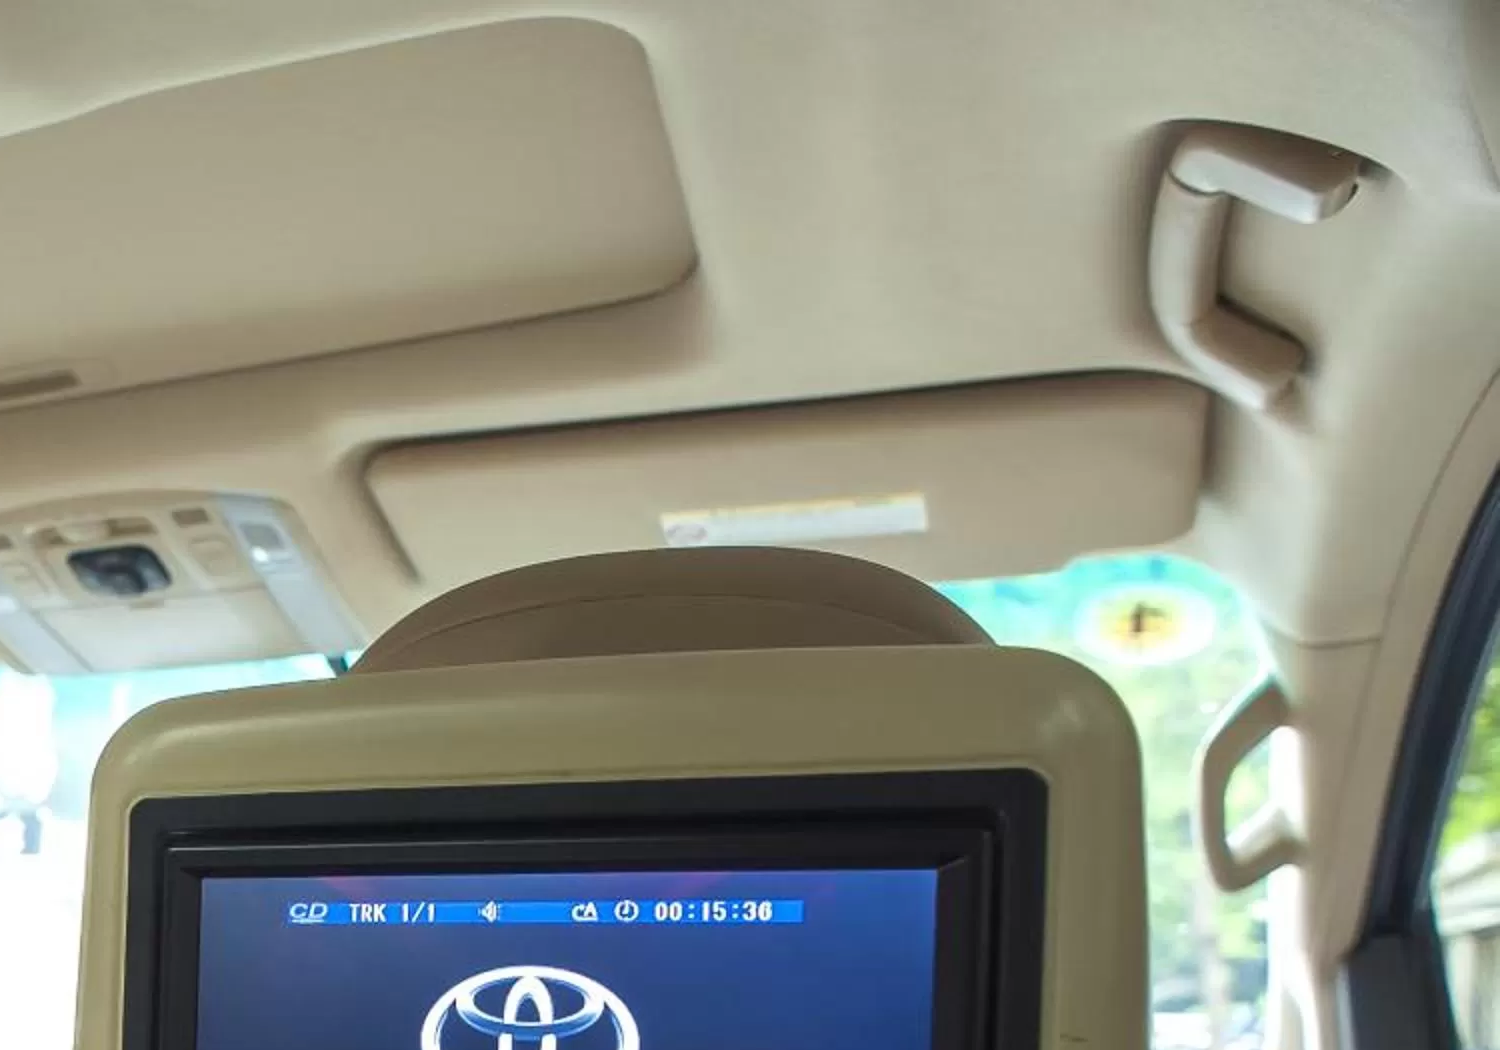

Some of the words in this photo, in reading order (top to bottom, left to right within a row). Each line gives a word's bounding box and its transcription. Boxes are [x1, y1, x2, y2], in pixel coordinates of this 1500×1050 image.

[288, 903, 329, 924] CD
[350, 903, 387, 923] TRK
[654, 900, 774, 922] 00:15:36
